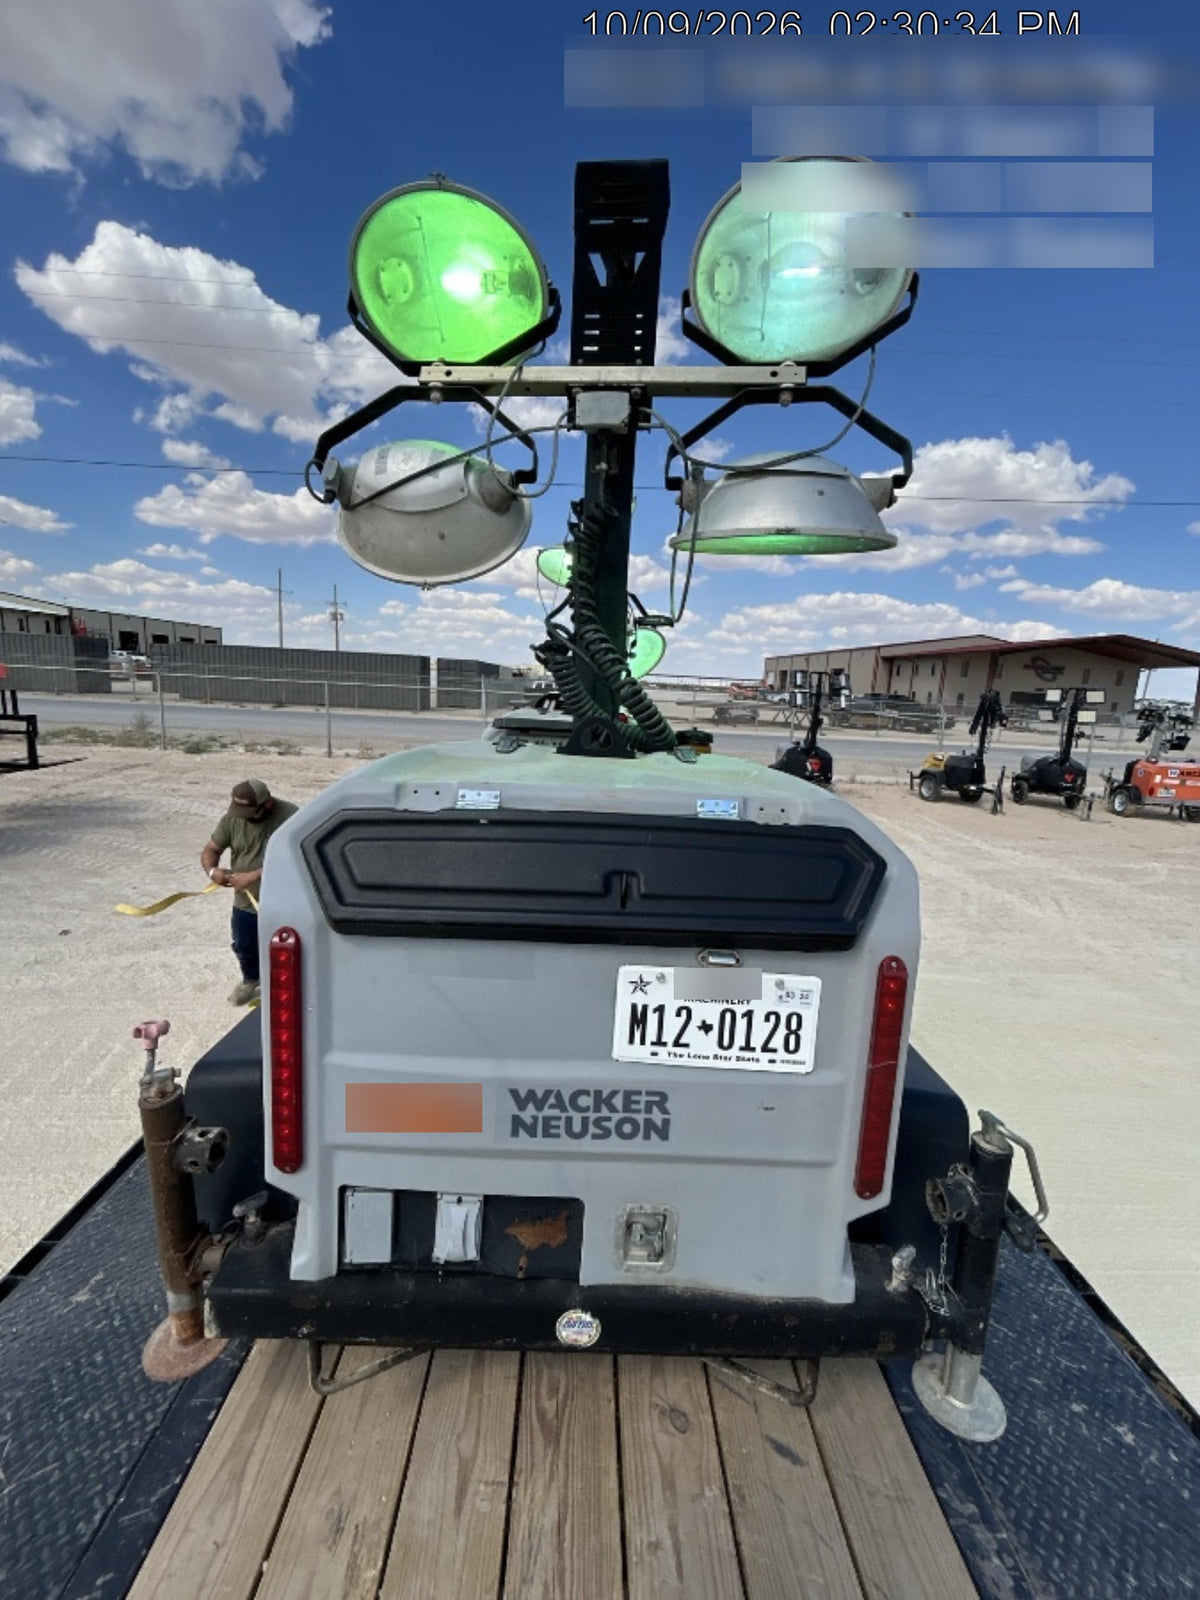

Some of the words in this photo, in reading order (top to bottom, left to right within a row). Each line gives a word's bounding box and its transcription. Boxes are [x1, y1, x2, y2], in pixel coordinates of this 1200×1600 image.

[627, 1002, 693, 1048] M12
[717, 1007, 803, 1055] 0128
[508, 1087, 671, 1115] WACKER
[510, 1115, 671, 1142] NEUSON
